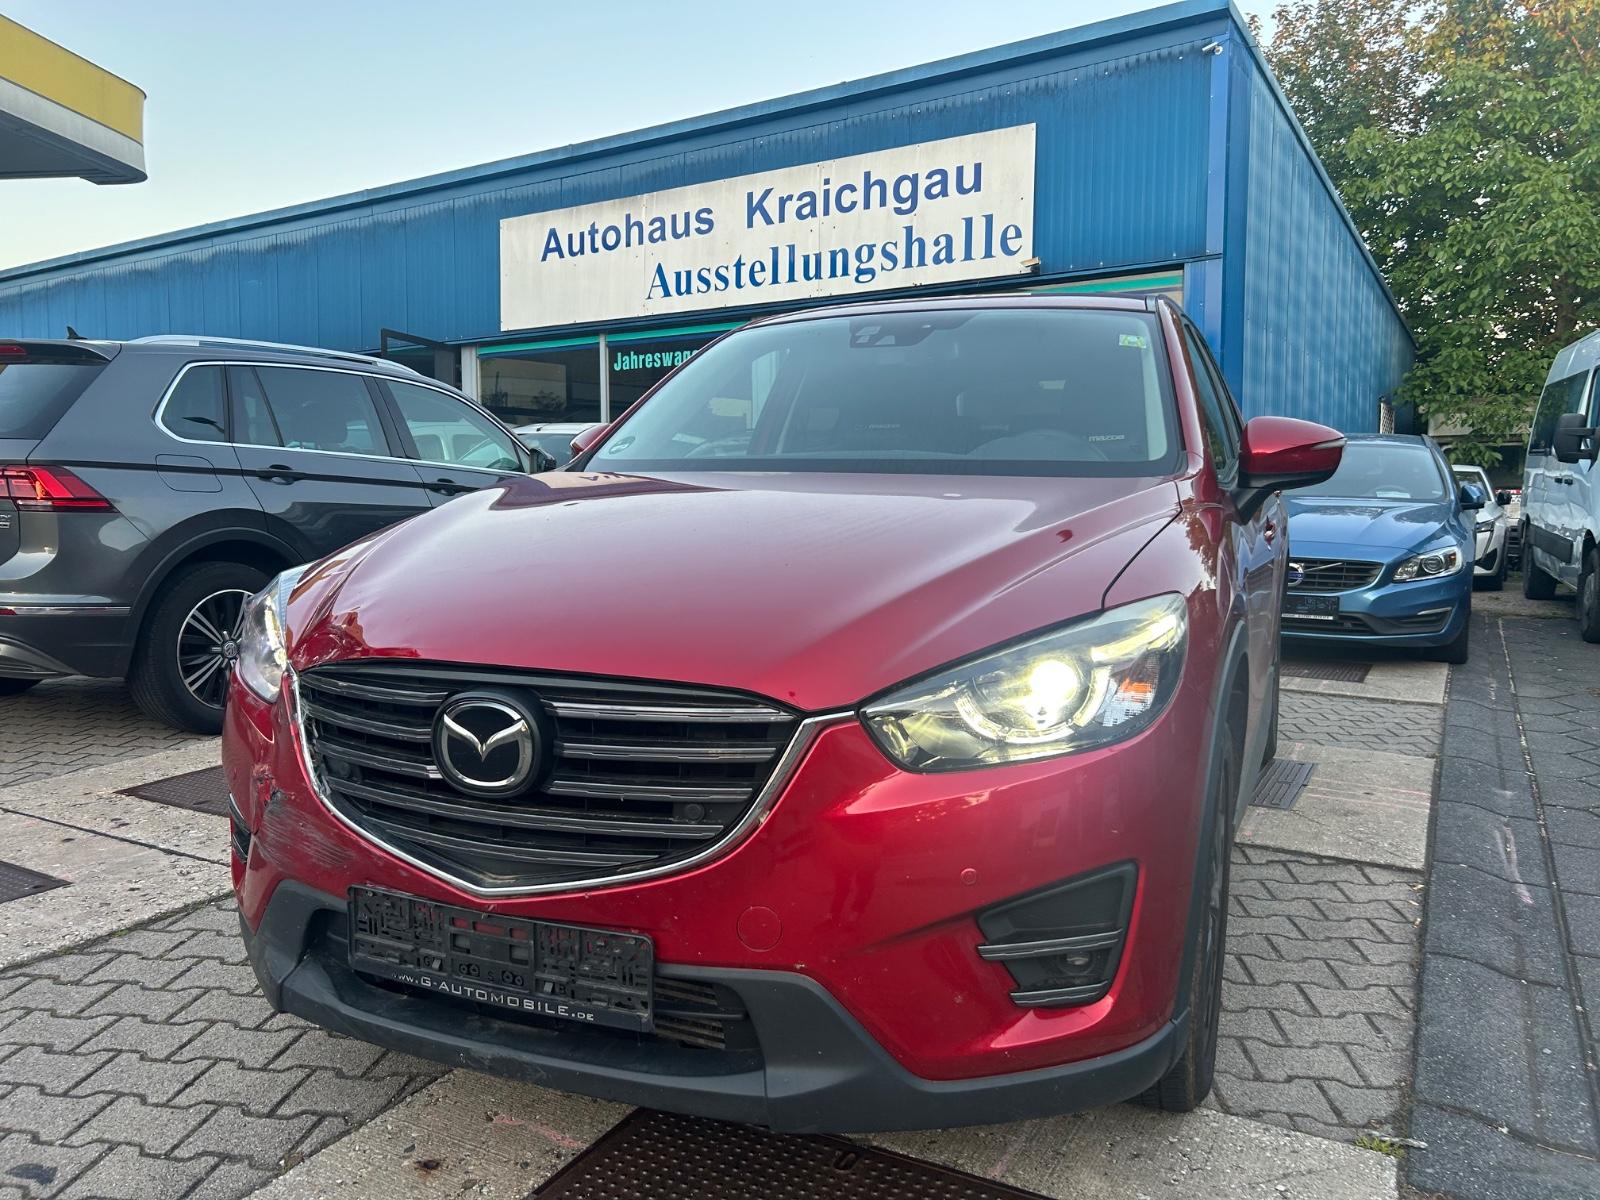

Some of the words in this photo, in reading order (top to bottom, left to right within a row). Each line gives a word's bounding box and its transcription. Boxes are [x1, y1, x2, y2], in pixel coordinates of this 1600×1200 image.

[540, 206, 715, 263] Autohaus
[746, 162, 983, 229] Kraichgau
[645, 213, 1023, 300] Ausstellungshalle
[613, 349, 699, 371] Jahreswa
